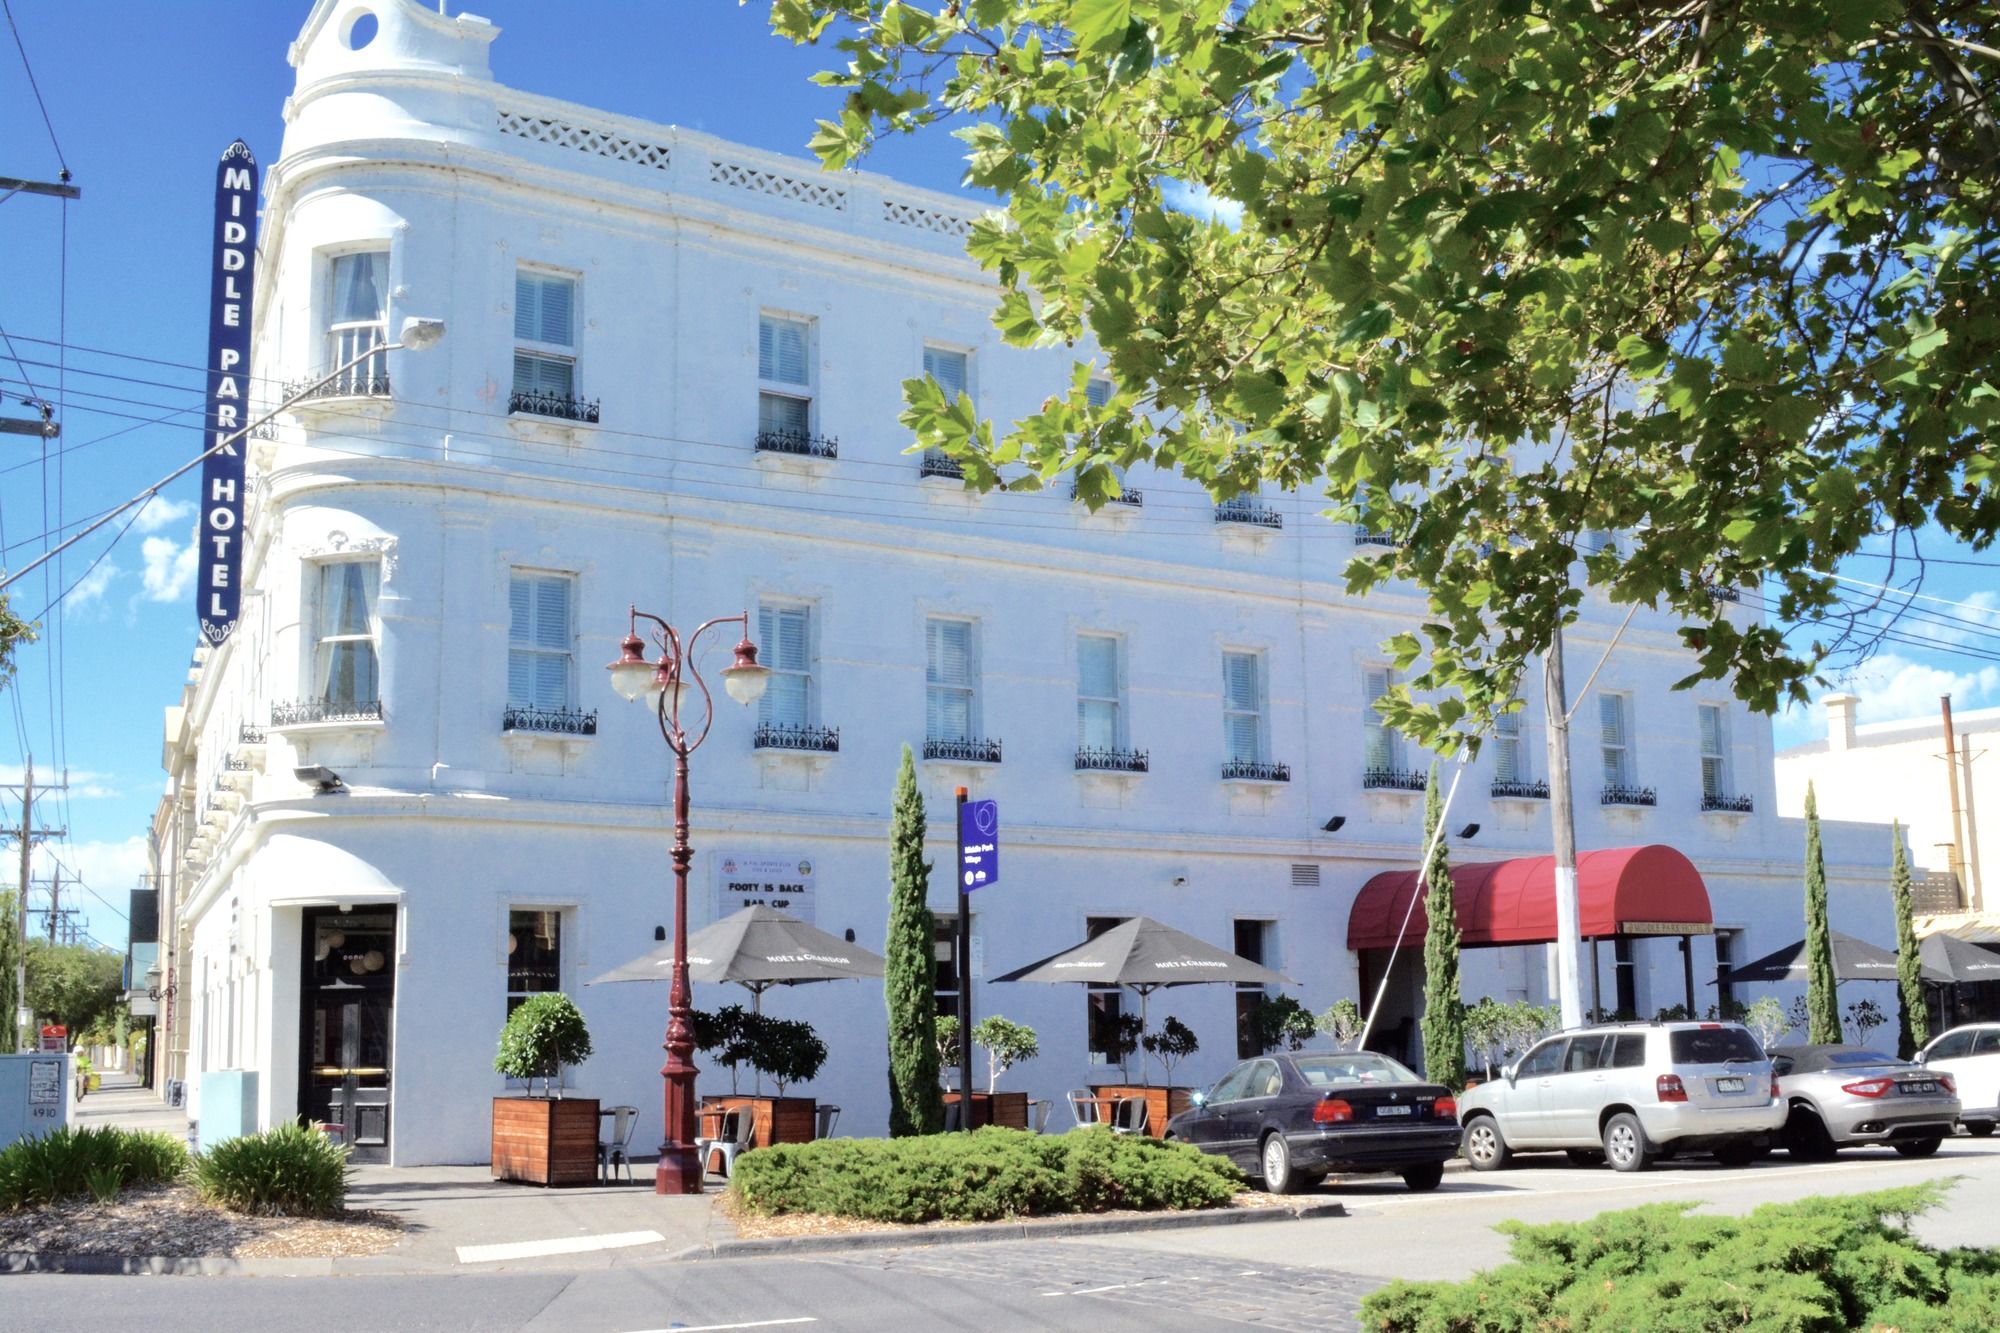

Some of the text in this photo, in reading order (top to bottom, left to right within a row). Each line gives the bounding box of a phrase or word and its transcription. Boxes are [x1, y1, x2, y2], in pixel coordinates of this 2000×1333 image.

[209, 167, 251, 616] MIDDLE PARK HOTEL
[729, 883, 805, 893] FOOTY IS BACK
[771, 899, 790, 908] CUP
[803, 953, 850, 964] CHANDON
